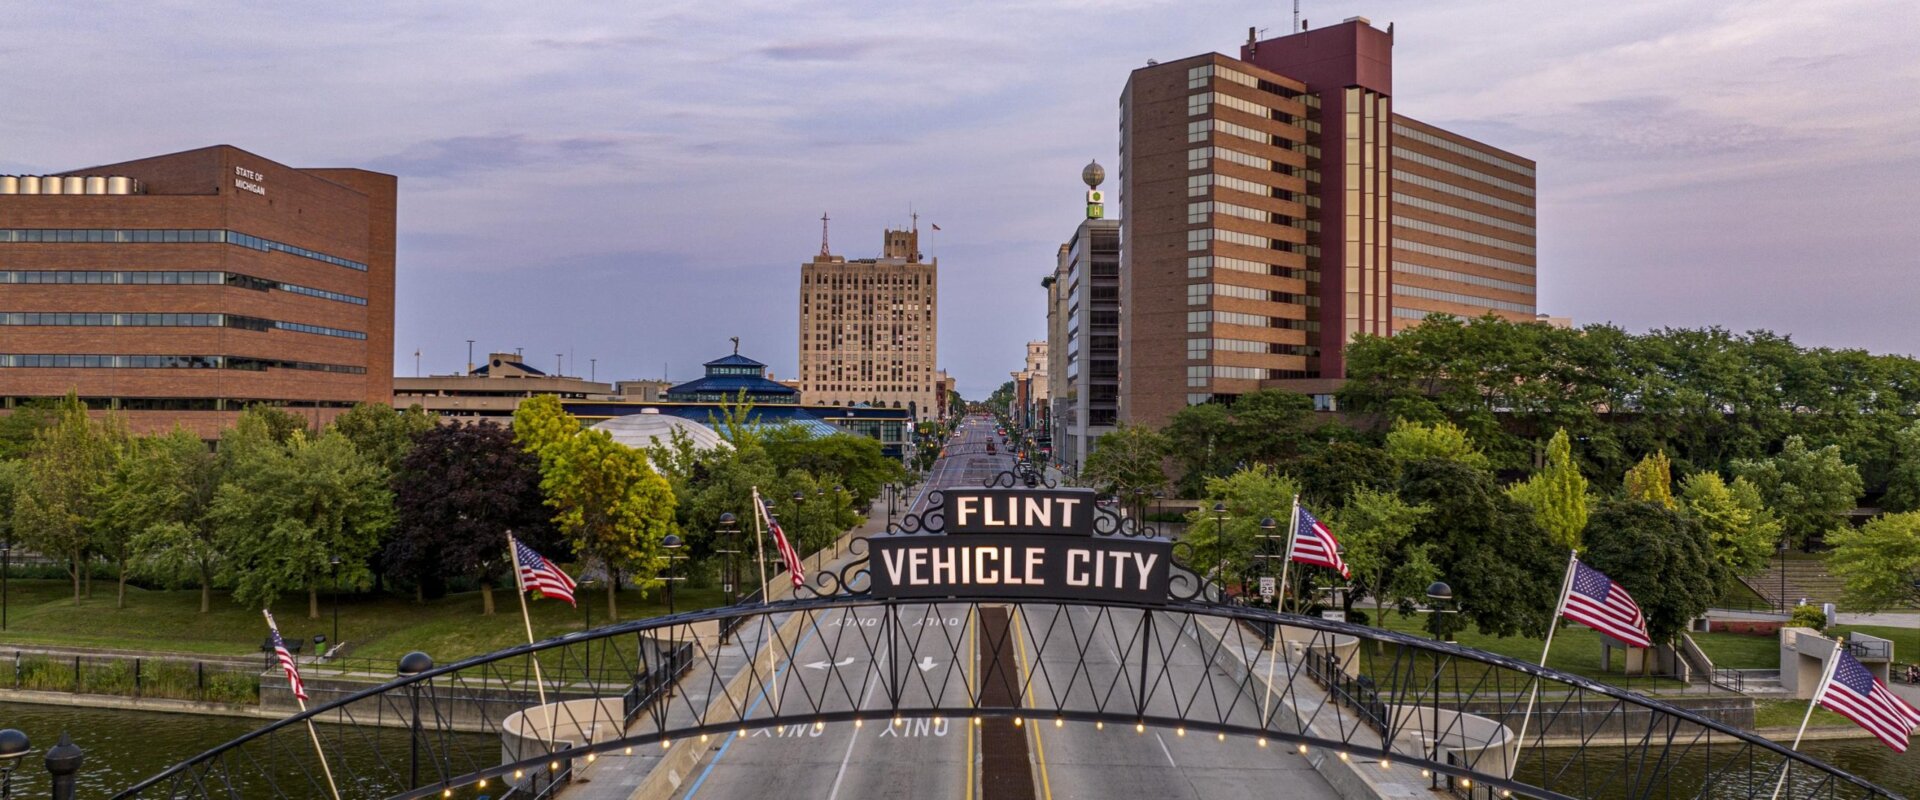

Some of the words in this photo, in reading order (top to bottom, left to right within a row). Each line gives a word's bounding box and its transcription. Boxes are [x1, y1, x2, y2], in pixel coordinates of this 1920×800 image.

[235, 166, 254, 179] STATE
[254, 172, 264, 182] OF
[235, 178, 265, 195] MICHIGAN
[957, 496, 1081, 528] FLINT
[881, 546, 1046, 586] VEHICLE
[1066, 548, 1159, 591] CITY
[828, 617, 878, 627] ONLY
[879, 717, 949, 738] ONLY
